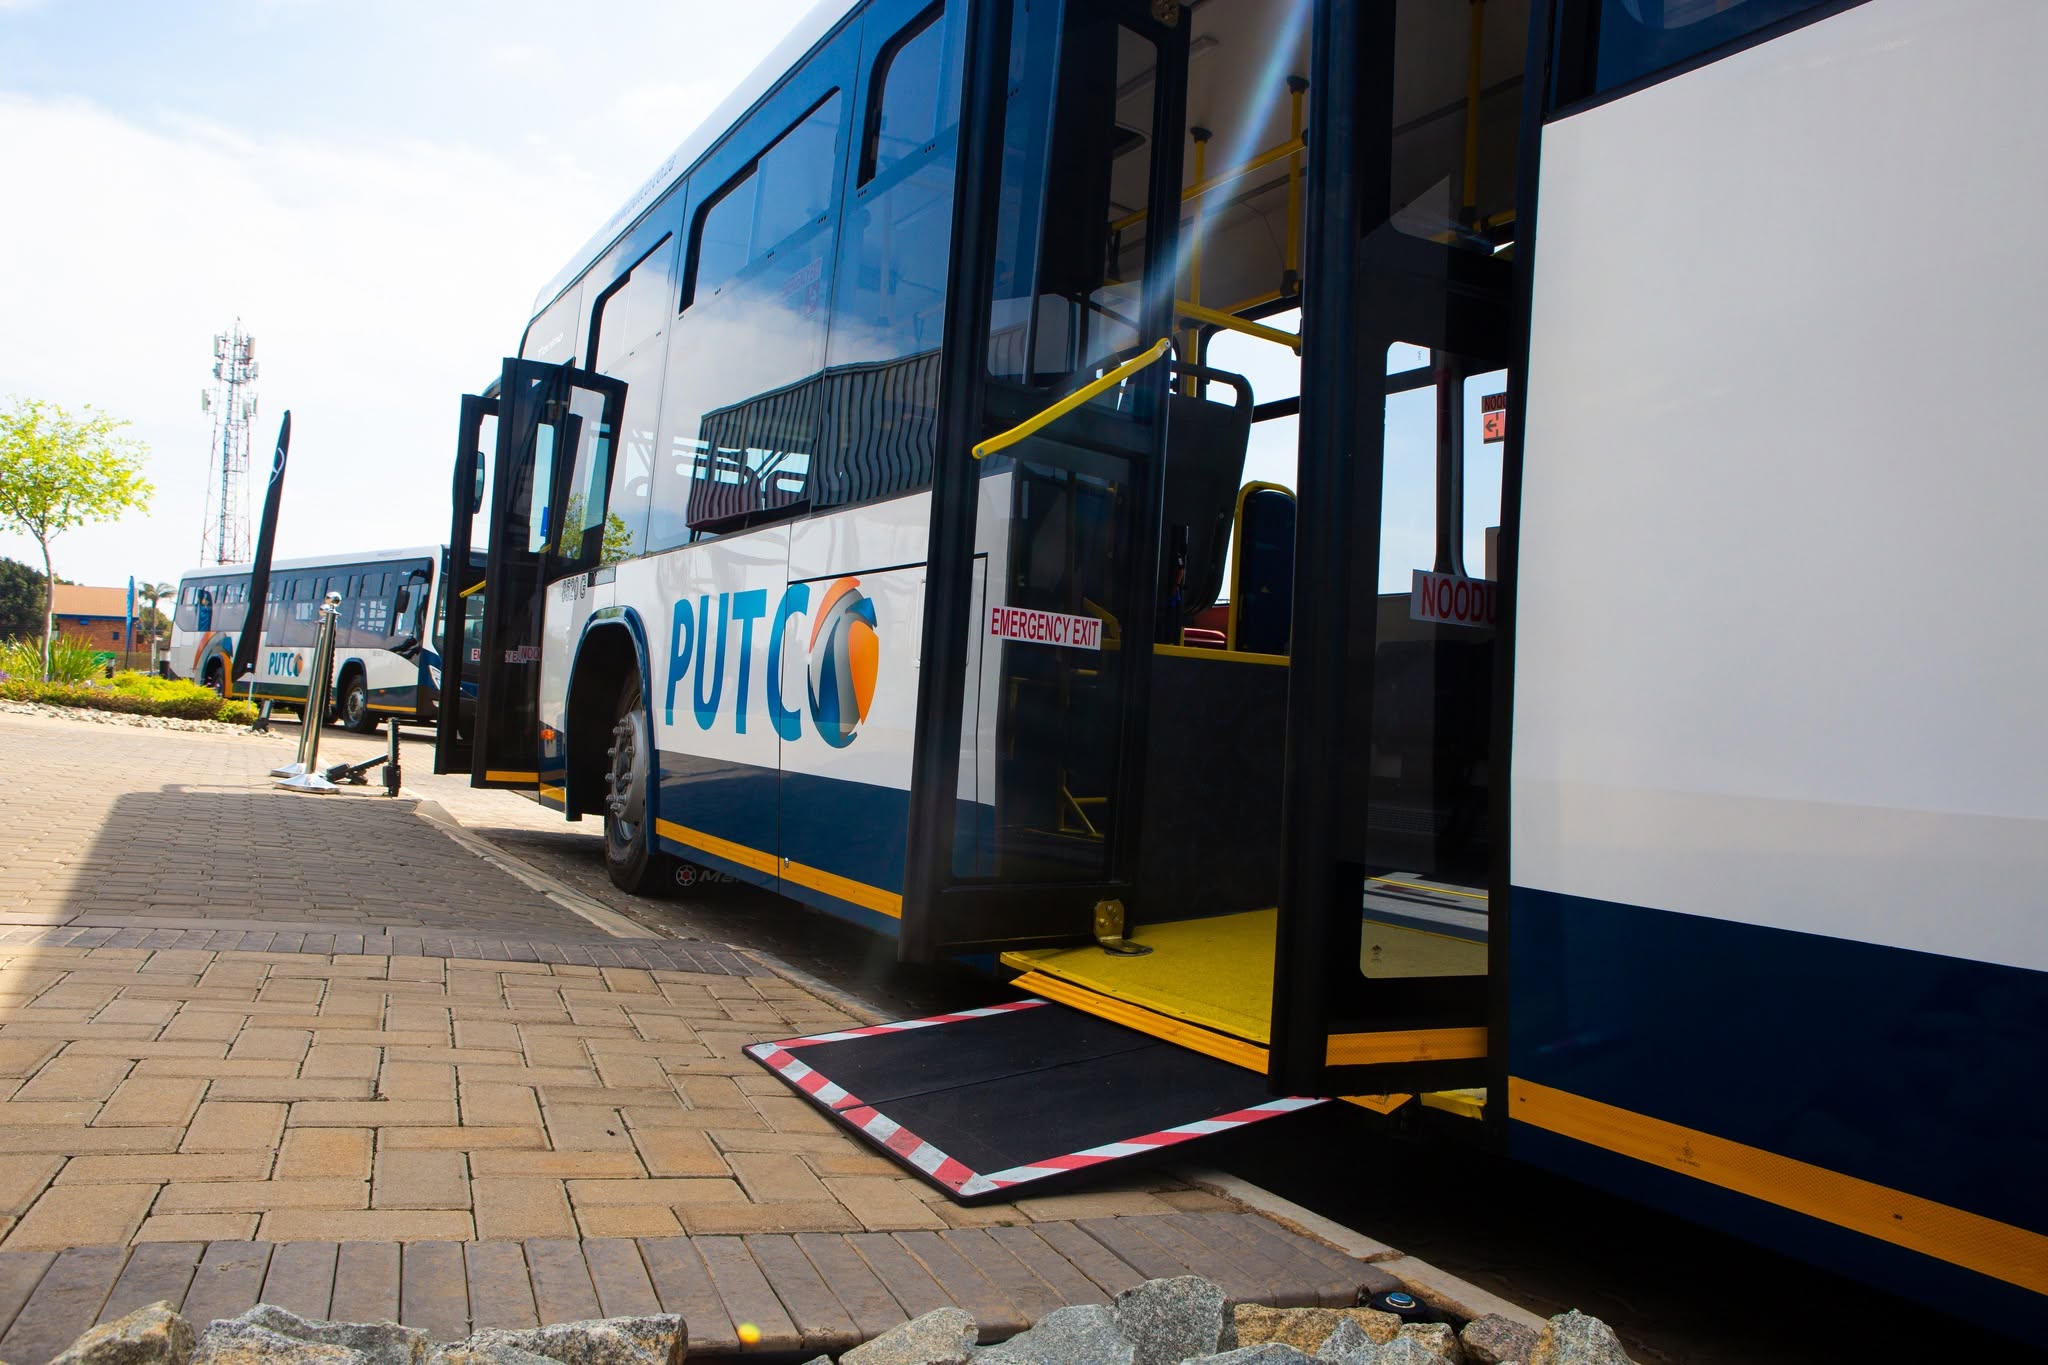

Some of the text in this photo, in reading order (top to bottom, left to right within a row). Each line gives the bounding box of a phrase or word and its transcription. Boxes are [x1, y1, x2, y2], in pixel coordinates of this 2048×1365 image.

[991, 607, 1099, 647] EMERGENCY EXIT
[268, 651, 304, 677] PUTCO
[665, 576, 879, 749] PUTCO
